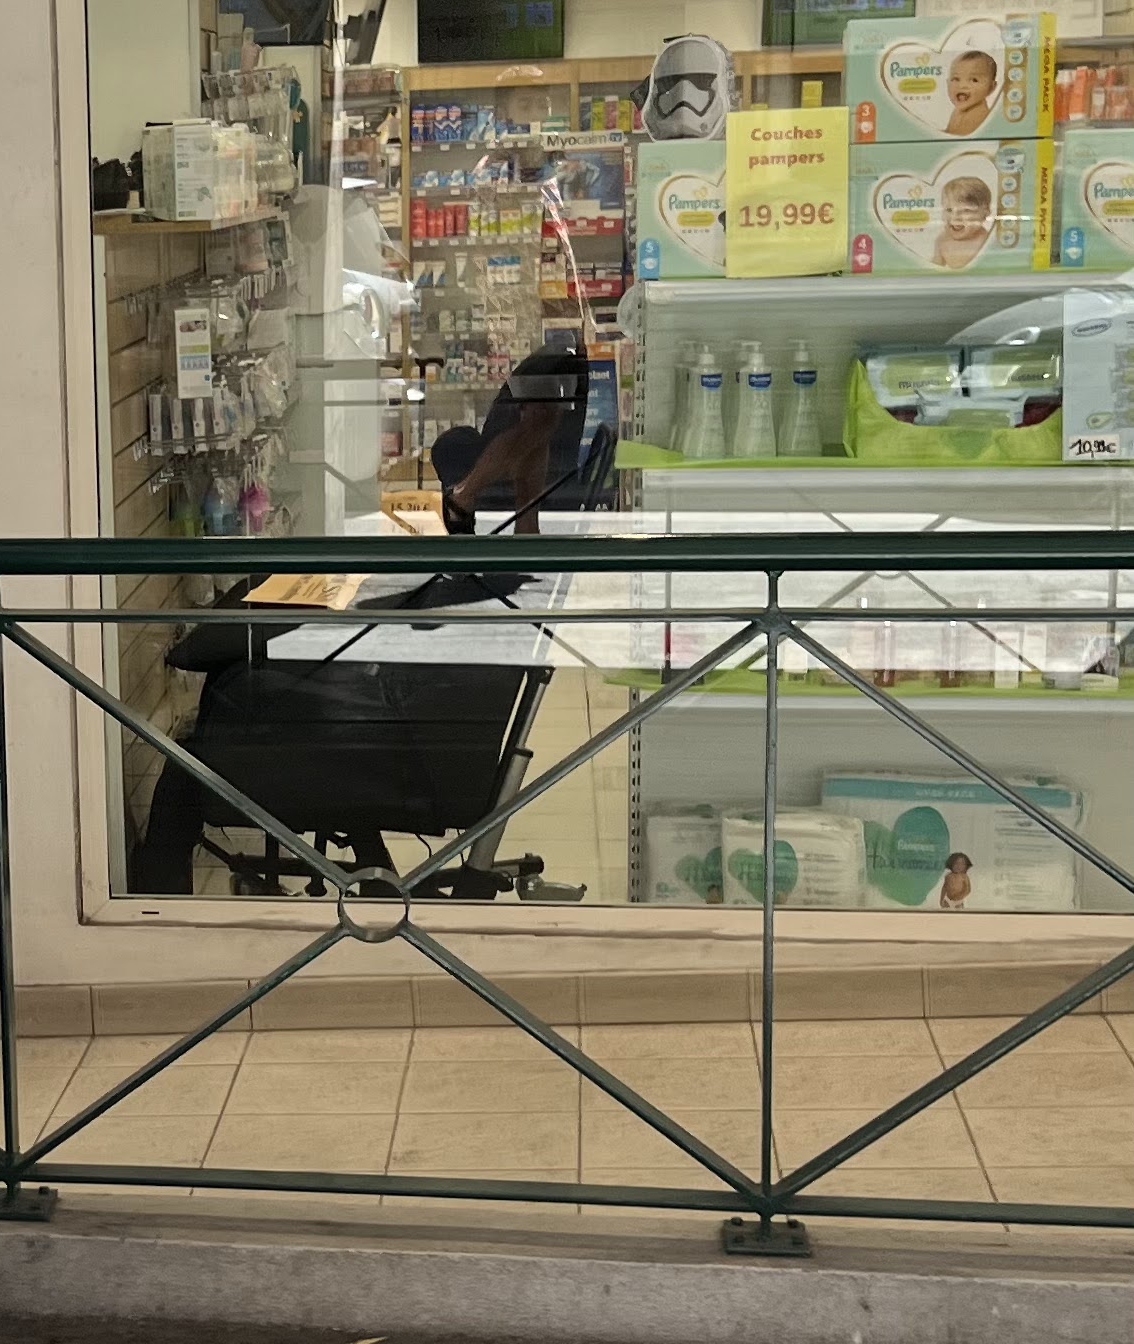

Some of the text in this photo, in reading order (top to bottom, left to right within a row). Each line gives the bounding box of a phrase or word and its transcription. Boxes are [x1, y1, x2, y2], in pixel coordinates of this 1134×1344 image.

[889, 61, 942, 79] Pampers
[861, 105, 870, 117] 3
[750, 125, 823, 142] Couches
[748, 151, 825, 170] pampers
[668, 194, 721, 211] Pampers
[882, 193, 935, 210] Pampers
[1039, 167, 1048, 242] MEGA PACK
[739, 202, 835, 231] 19,99€
[858, 238, 867, 250] 4
[1069, 230, 1078, 243] 5
[645, 241, 655, 254] 5
